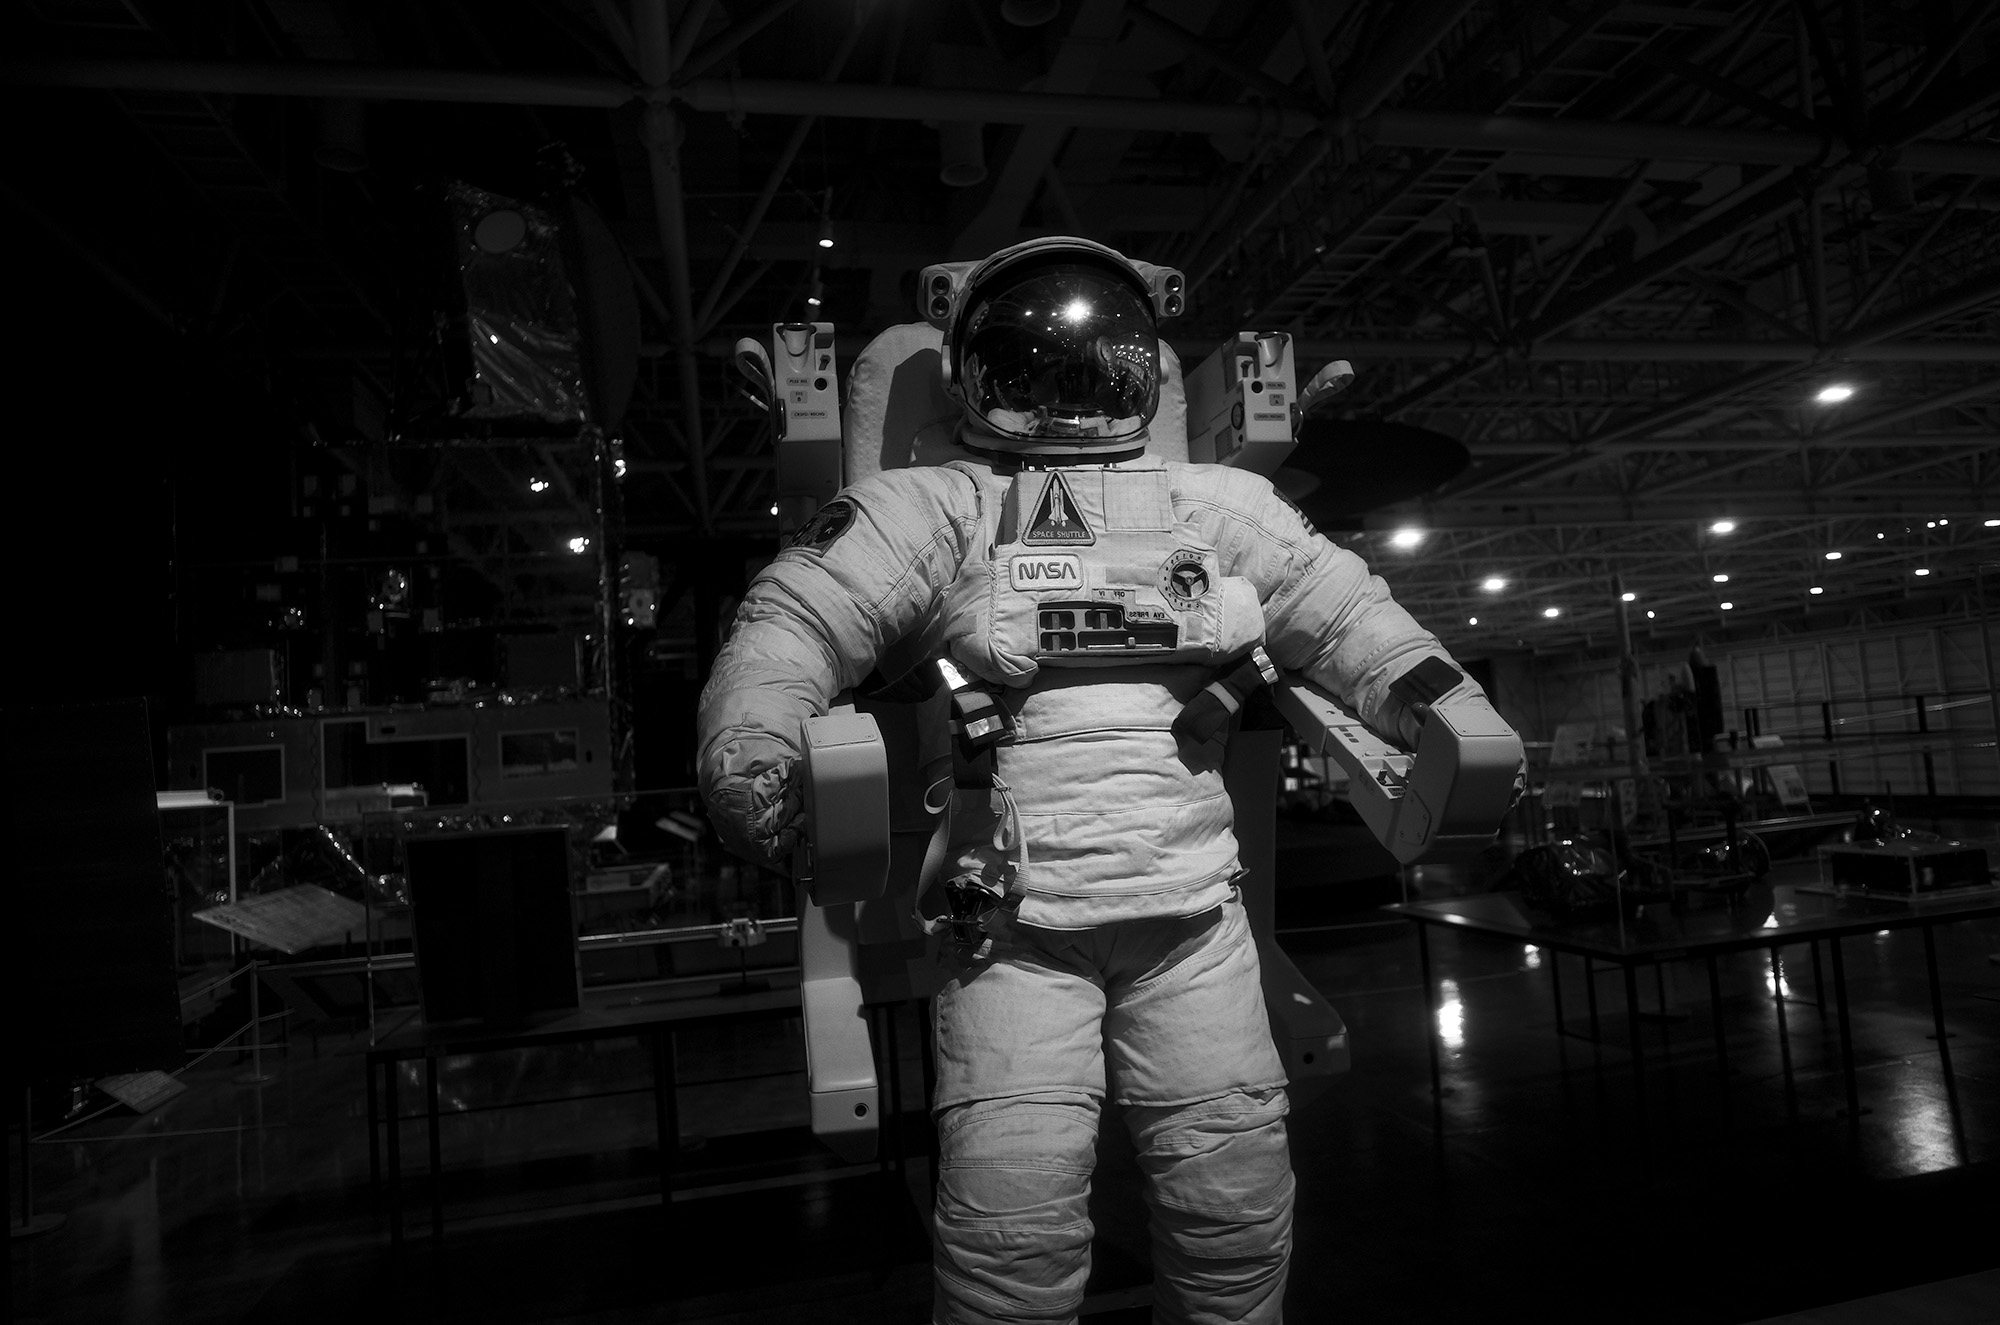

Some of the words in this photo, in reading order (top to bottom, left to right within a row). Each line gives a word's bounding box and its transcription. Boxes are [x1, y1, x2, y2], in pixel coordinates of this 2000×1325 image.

[1032, 530, 1054, 538] SPACE
[1056, 530, 1086, 538] SHUTTLE
[1018, 562, 1077, 580] NASA
